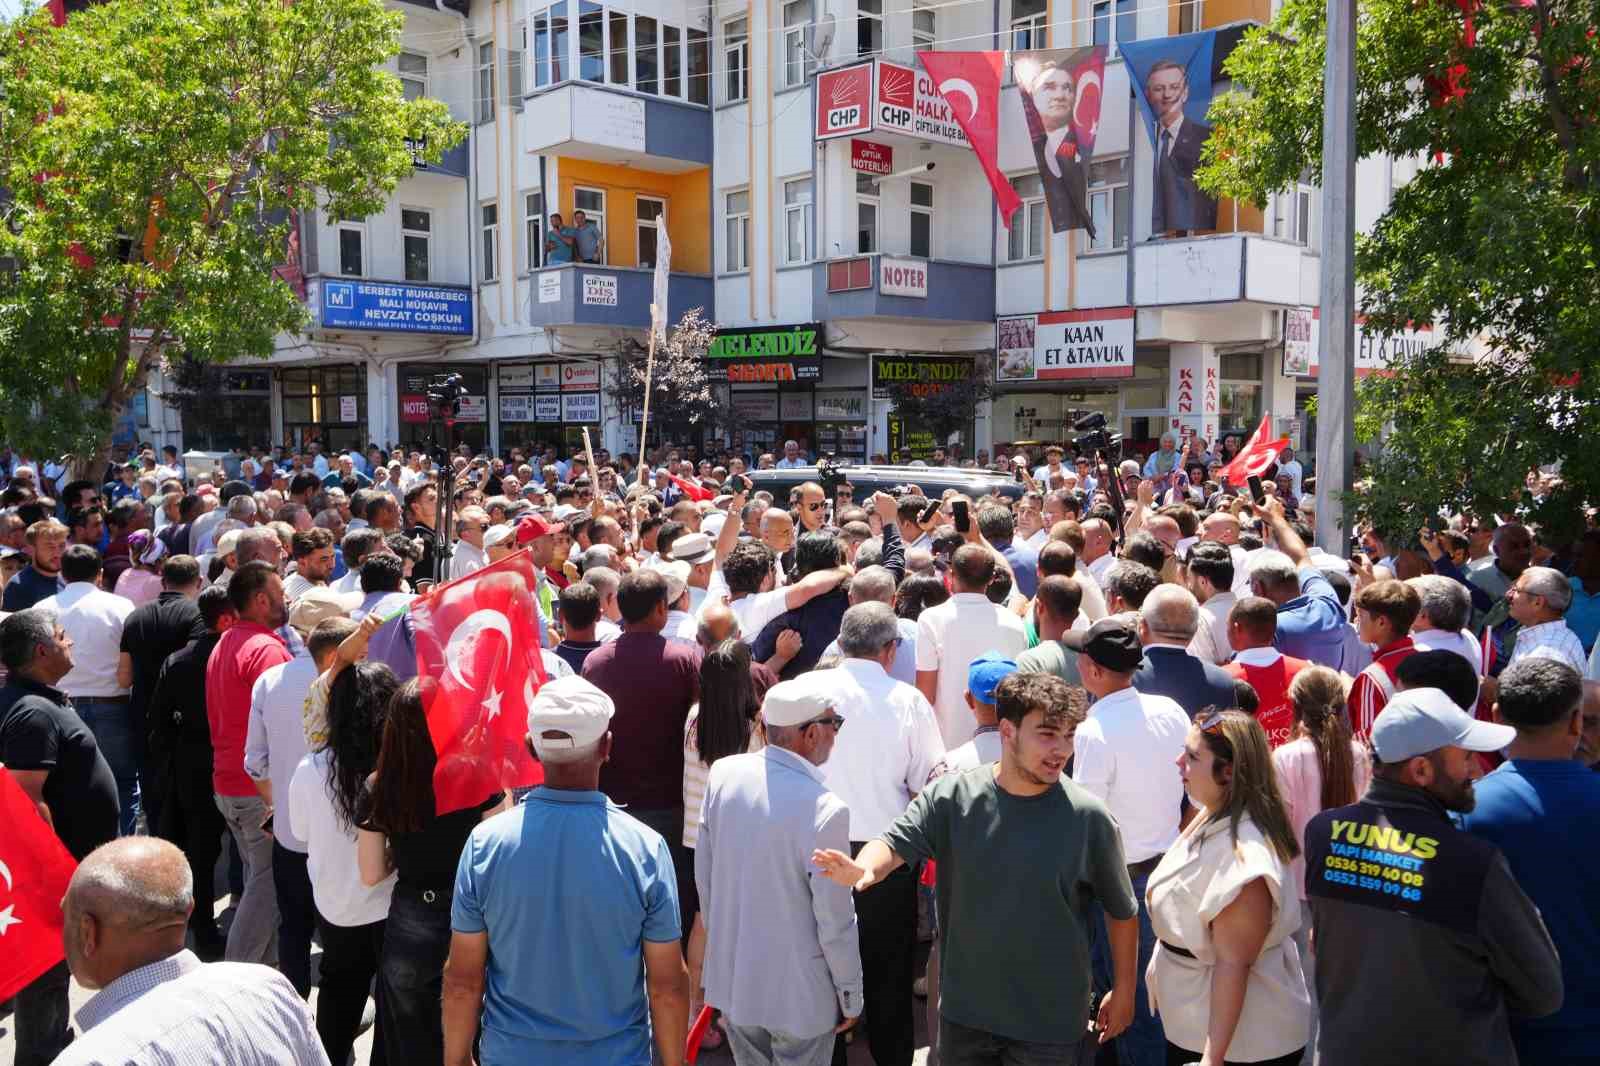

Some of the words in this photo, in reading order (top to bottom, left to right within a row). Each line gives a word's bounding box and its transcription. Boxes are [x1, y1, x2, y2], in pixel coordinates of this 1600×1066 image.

[830, 108, 858, 127] CHP
[881, 106, 911, 127] CHP
[916, 99, 948, 122] HALK
[884, 266, 925, 289] NOTER
[358, 285, 403, 297] SERBEST
[365, 309, 412, 321] NEVZAT
[415, 312, 462, 325] COŞKUN
[1064, 325, 1104, 344] KAAN
[1045, 348, 1062, 365] ET
[1178, 367, 1193, 413] KAAN
[1206, 367, 1216, 412] KAAN
[1331, 820, 1440, 859] YUNUS
[1330, 842, 1361, 858] YAPI
[1362, 849, 1424, 871] MARKET
[1325, 856, 1358, 872] 0536
[1402, 872, 1424, 887] 08
[1323, 870, 1358, 886] 0552
[1401, 887, 1422, 901] 68
